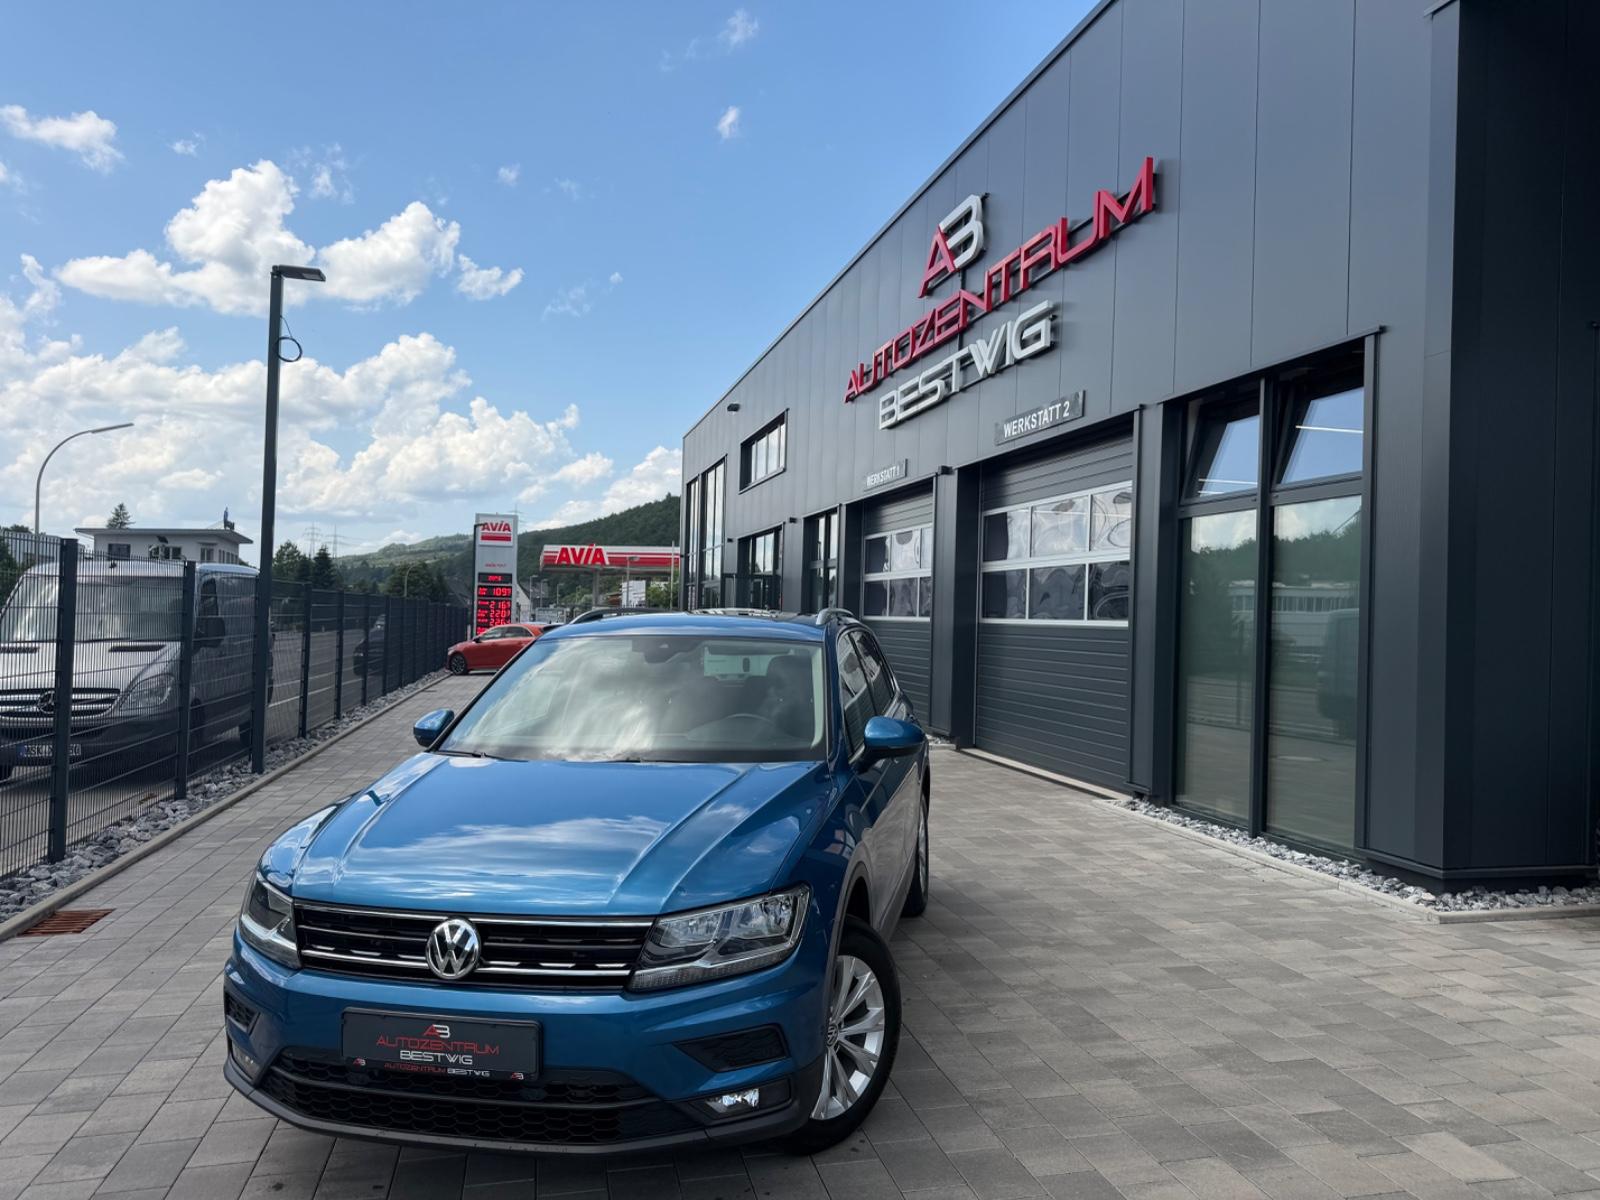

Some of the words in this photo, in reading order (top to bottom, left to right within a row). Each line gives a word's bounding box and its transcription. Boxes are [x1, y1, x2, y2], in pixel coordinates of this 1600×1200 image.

[844, 156, 1155, 404] AUTOZENTRUM
[879, 299, 1054, 430] BESTWIG
[1003, 403, 1062, 438] WERKSTATT
[1062, 400, 1070, 418] 2
[866, 465, 897, 487] WERKSTATT
[376, 1035, 499, 1055] AUTOZENTRUM
[399, 1049, 474, 1065] BESTWIG
[384, 1063, 446, 1074] AUTOZENTRUM
[447, 1067, 490, 1077] BESTWIG
